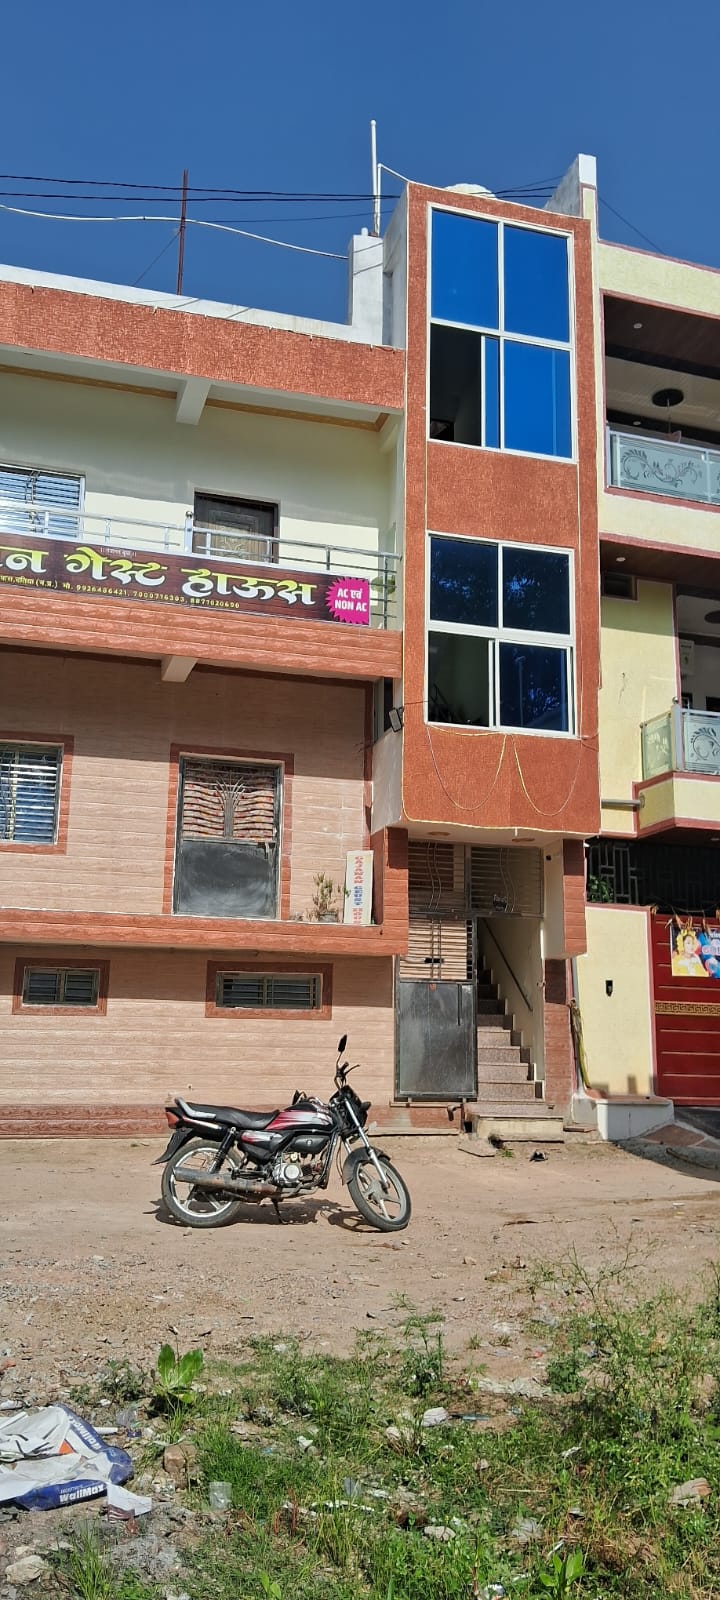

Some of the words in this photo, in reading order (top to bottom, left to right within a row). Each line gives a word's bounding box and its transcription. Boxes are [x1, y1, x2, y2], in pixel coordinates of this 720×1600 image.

[0, 546, 49, 573] न
[64, 546, 168, 586] गेस्ट
[181, 568, 317, 605] हाऊस
[337, 588, 348, 598] AC
[335, 599, 354, 610] NON
[356, 602, 367, 612] AC
